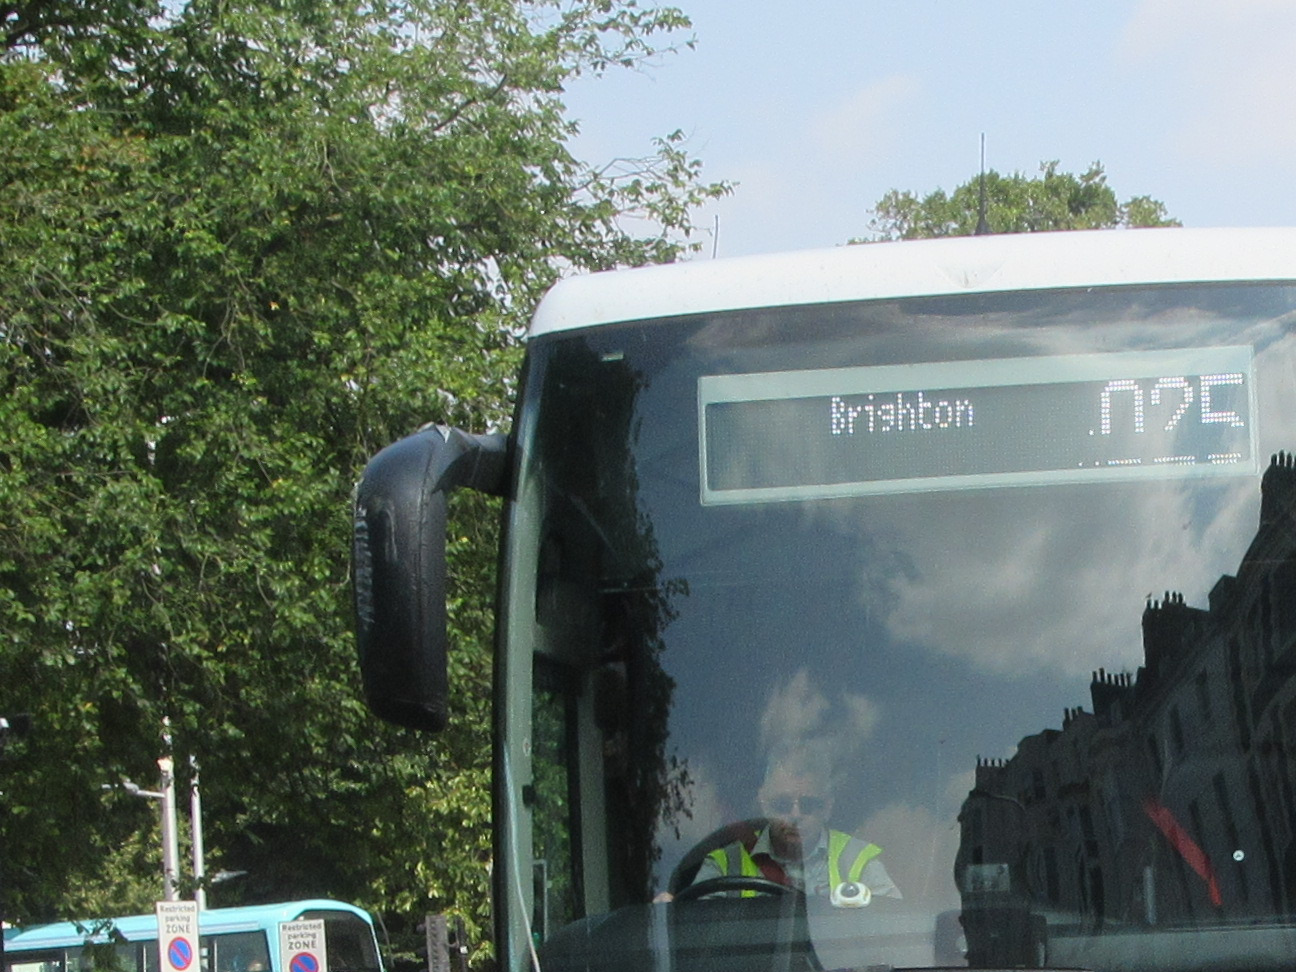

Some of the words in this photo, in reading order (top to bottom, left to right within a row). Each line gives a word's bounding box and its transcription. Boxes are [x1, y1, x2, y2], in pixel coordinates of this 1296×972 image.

[831, 391, 974, 435] Brighton
[160, 904, 195, 912] Restricted
[165, 915, 191, 923] parking
[166, 924, 191, 934] ZONE
[282, 923, 322, 931] Restricted
[287, 932, 317, 940] parking
[288, 940, 317, 950] ZONE
